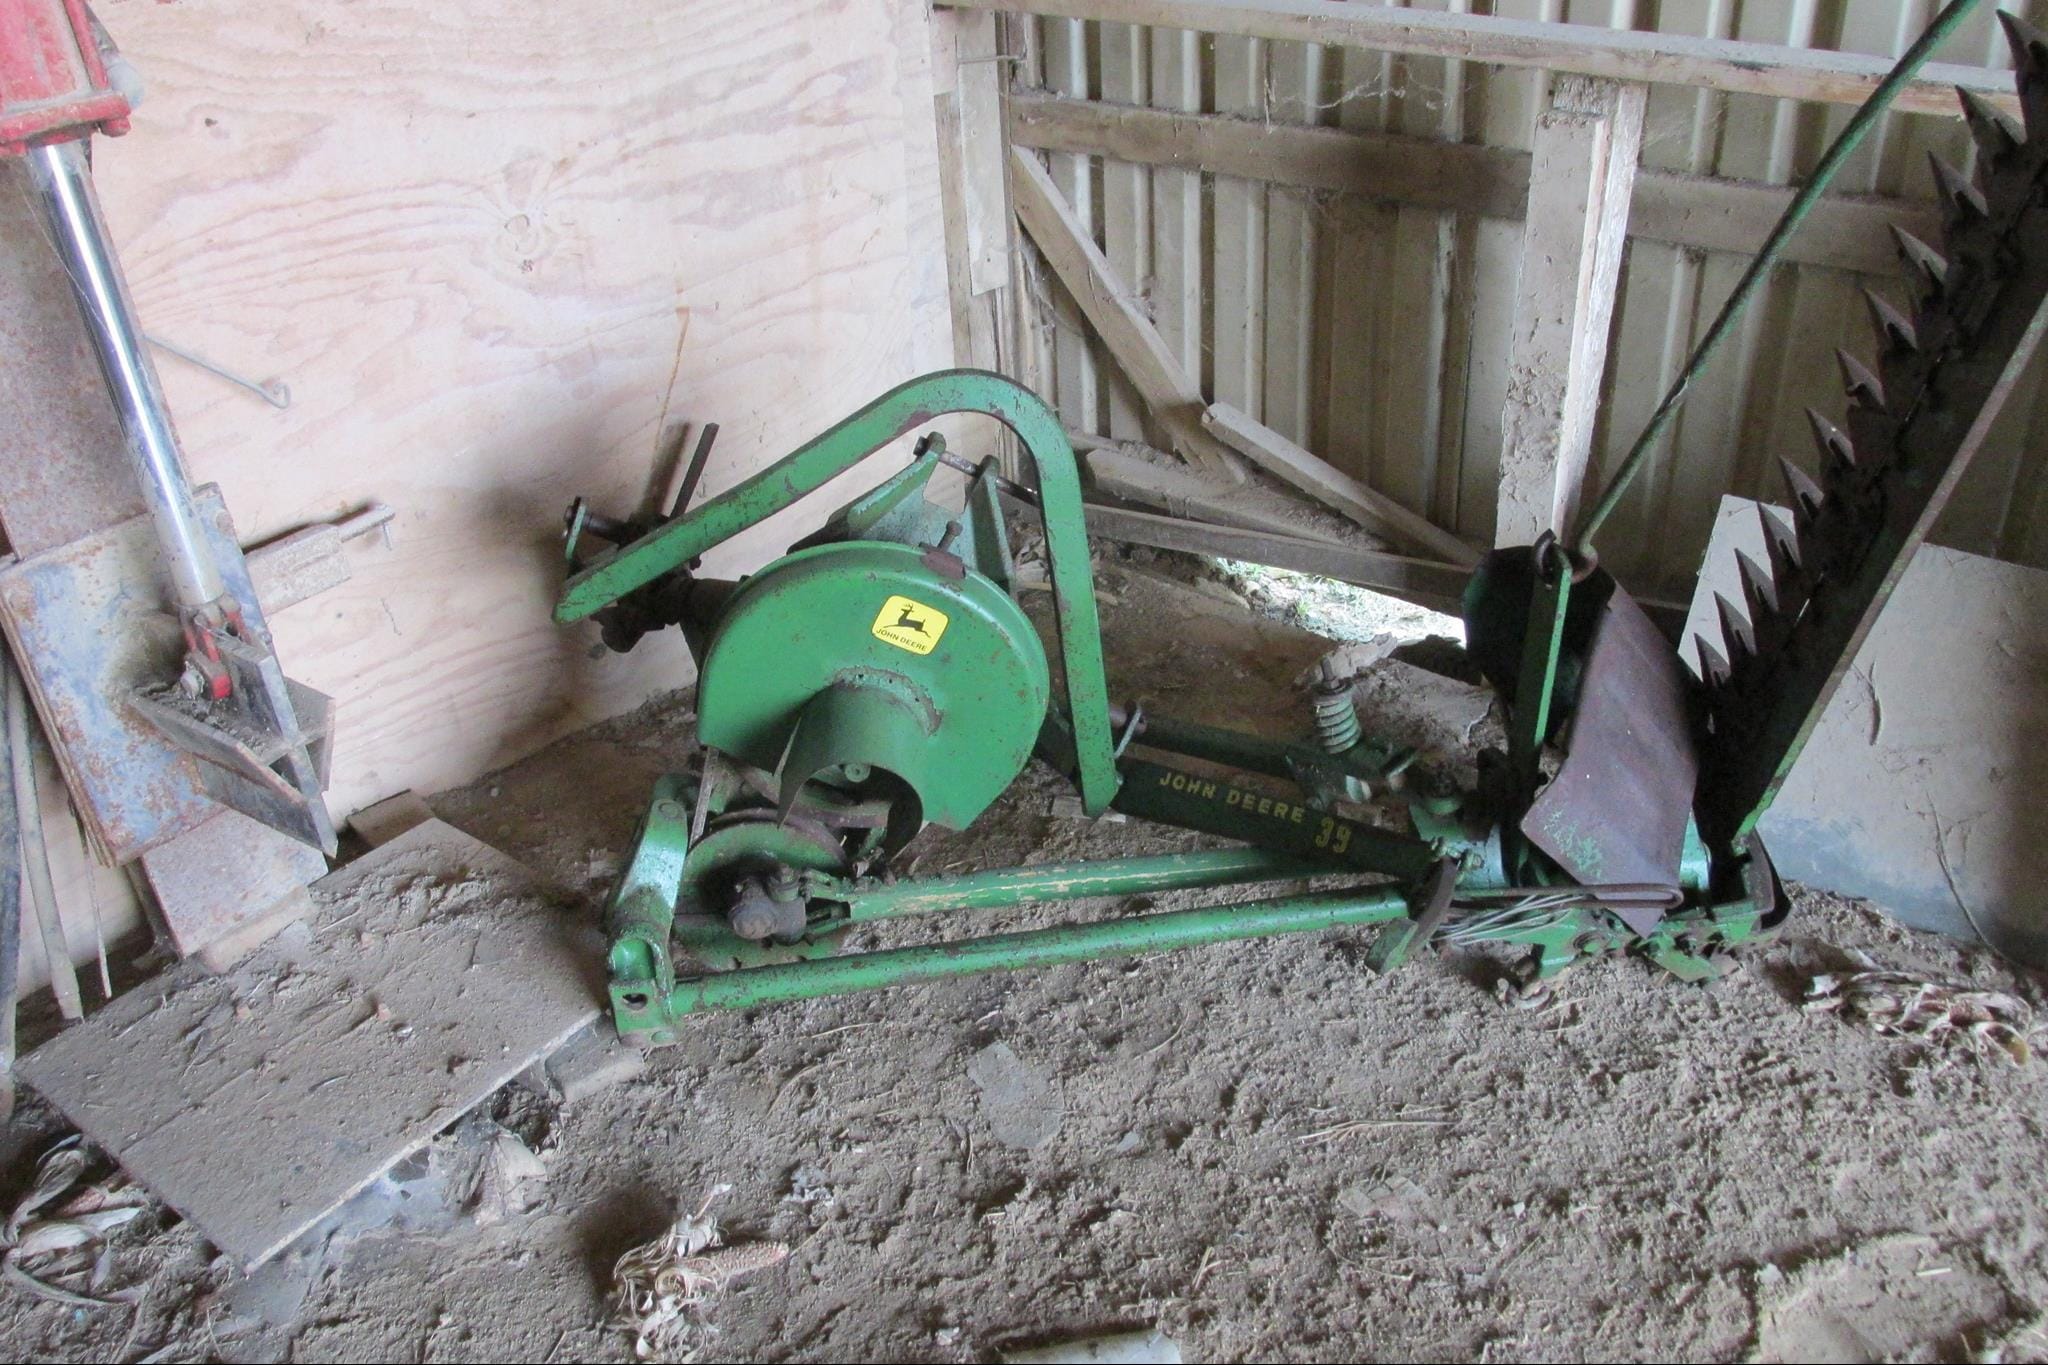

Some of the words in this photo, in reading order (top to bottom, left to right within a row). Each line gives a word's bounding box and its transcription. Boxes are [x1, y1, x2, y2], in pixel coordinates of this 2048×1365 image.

[876, 628, 899, 641] JOHN
[900, 636, 927, 651] DEERE
[1159, 772, 1217, 799] JOHN
[1226, 788, 1306, 823] DEERE
[1315, 817, 1351, 853] 39
